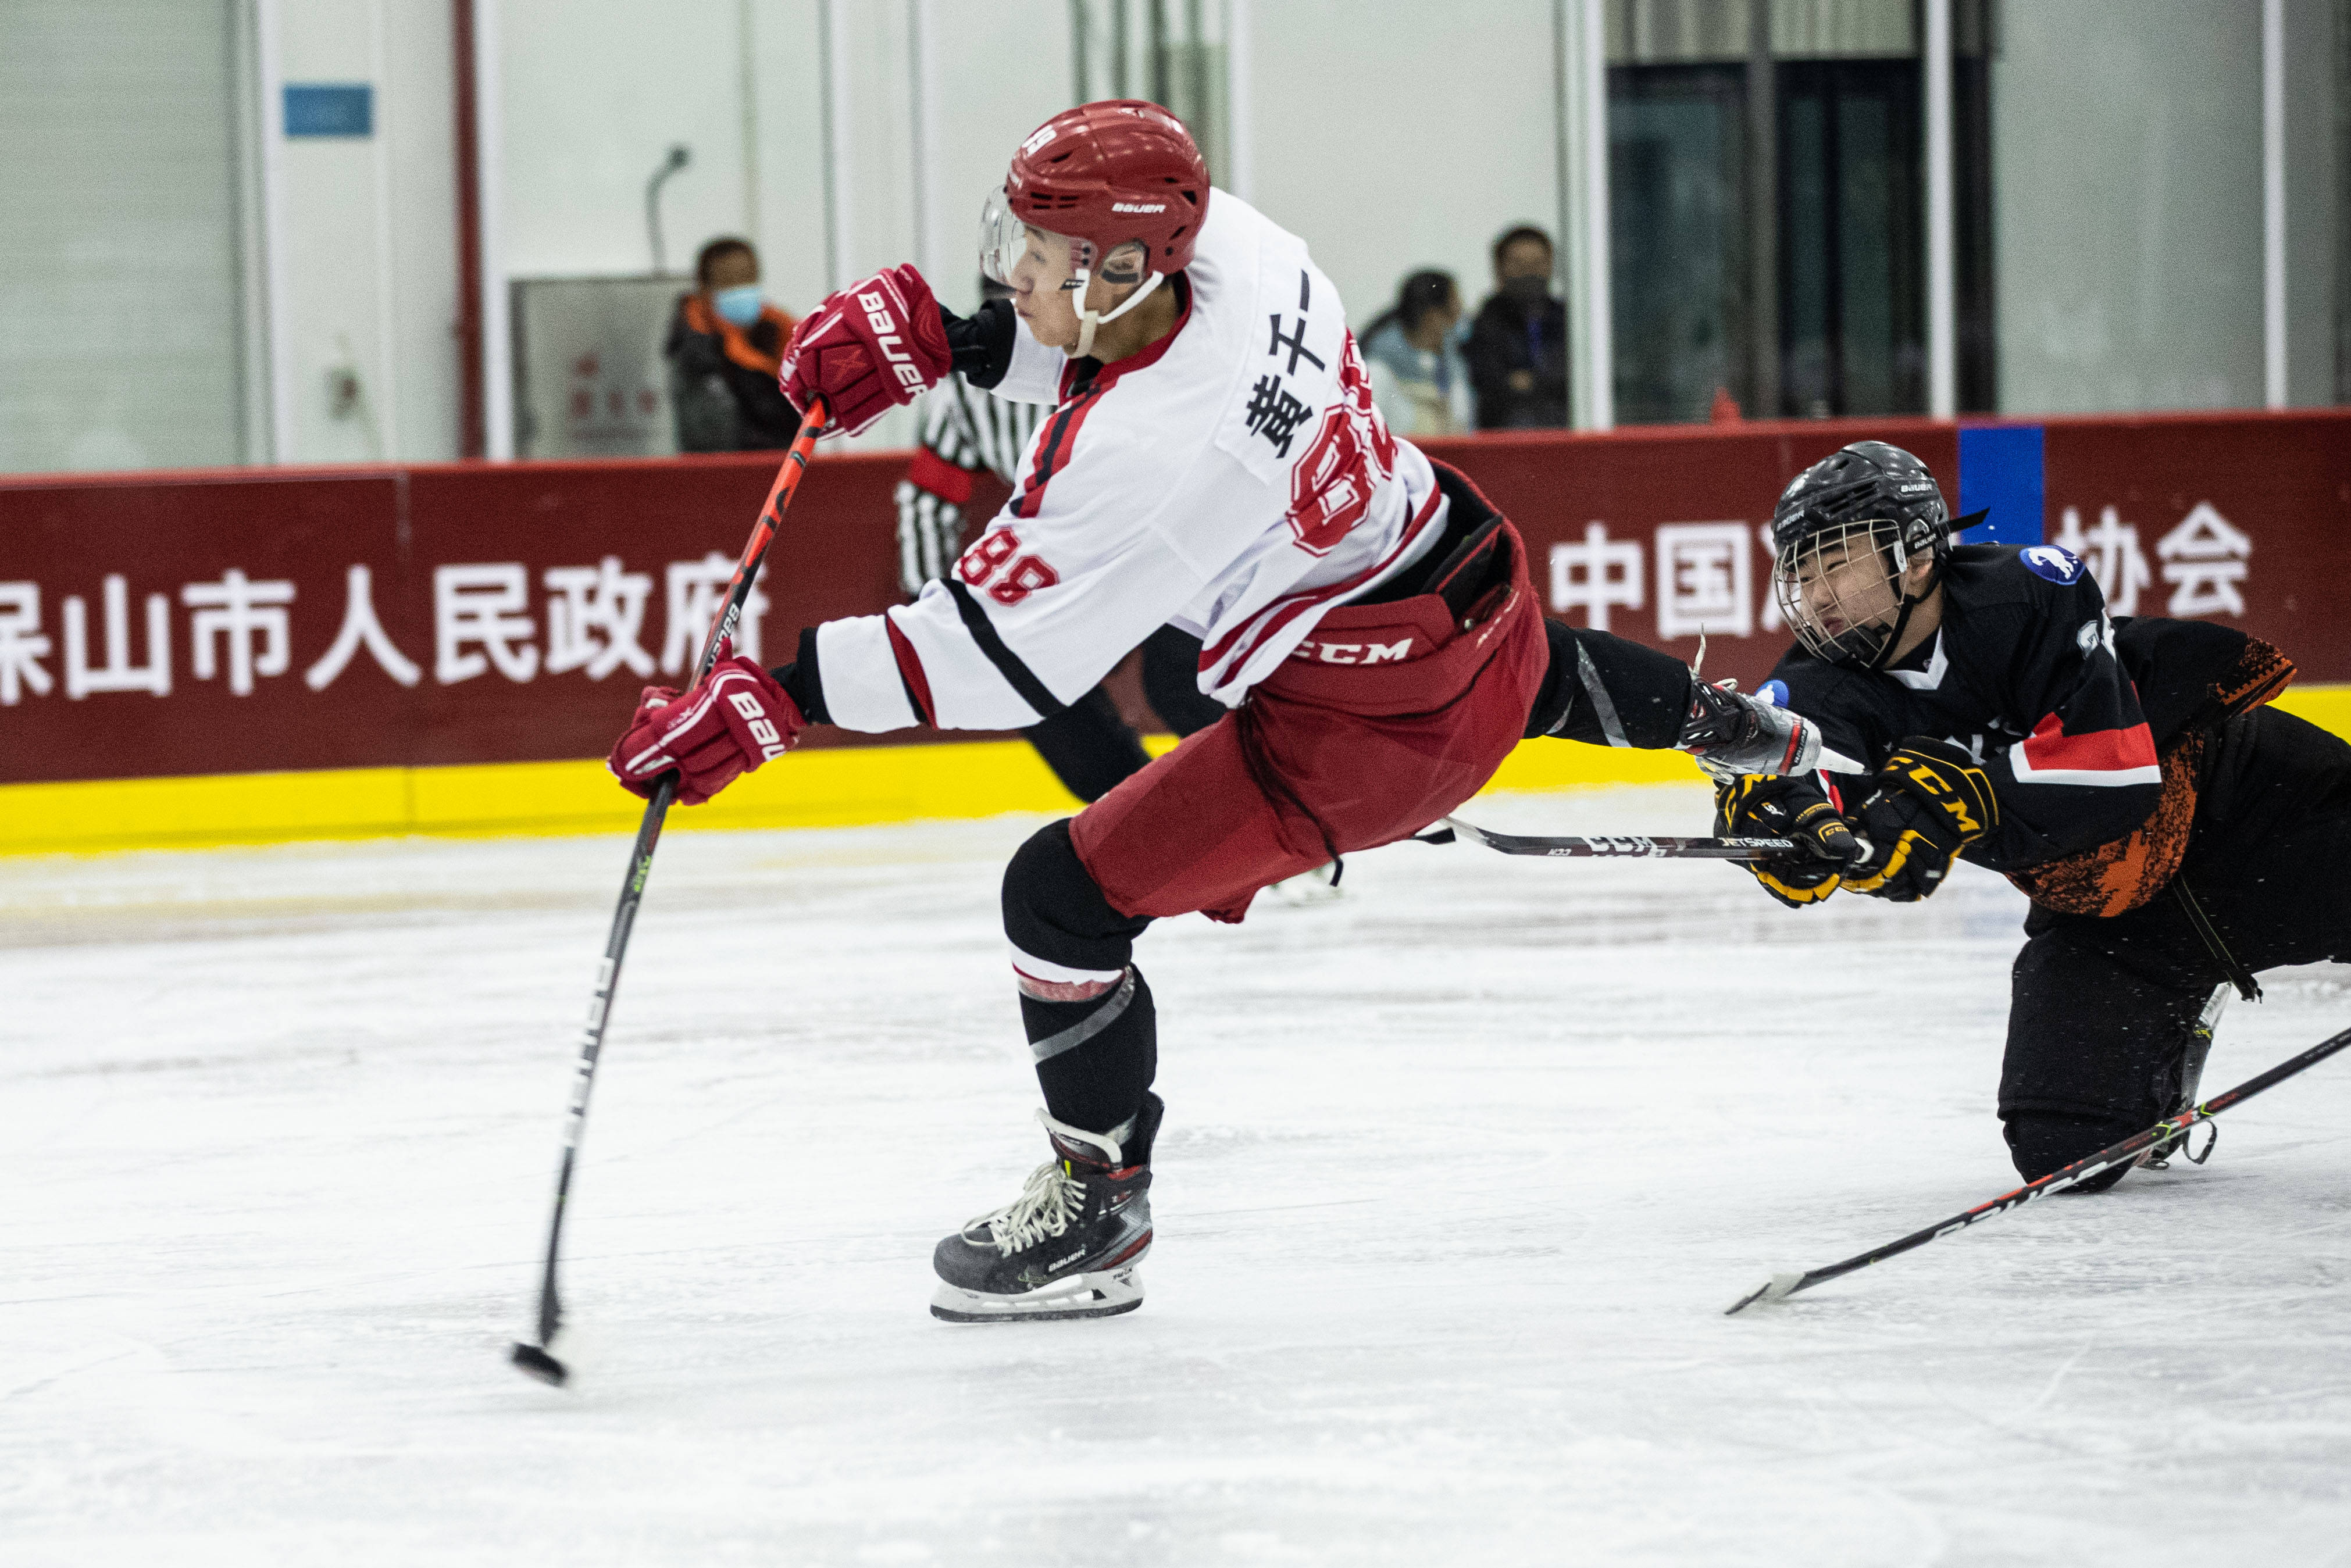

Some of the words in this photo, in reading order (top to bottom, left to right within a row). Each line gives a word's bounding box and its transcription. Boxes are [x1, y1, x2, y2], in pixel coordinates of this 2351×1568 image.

[1112, 202, 1166, 213] BAUER
[1245, 268, 1326, 459] 黄千一
[958, 526, 1060, 608] 88
[1291, 638, 1414, 665] CM
[1717, 837, 1795, 848] JETSPEED
